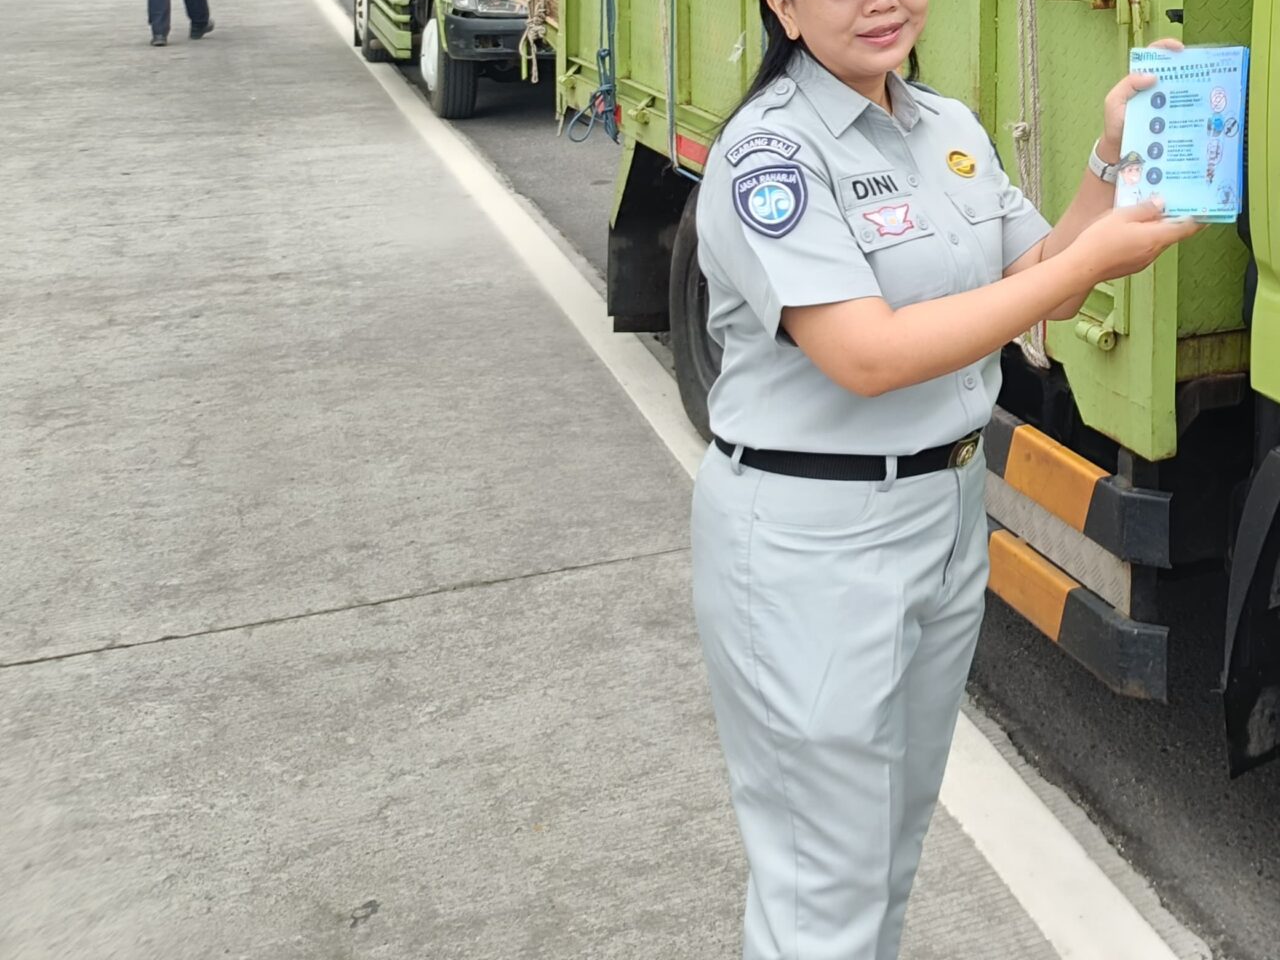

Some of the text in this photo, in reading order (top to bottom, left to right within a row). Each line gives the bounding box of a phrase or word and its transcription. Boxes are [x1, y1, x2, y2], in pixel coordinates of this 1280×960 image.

[770, 139, 793, 155] BALI
[739, 173, 797, 193] JASA RAHARJA
[852, 174, 898, 200] DINI
